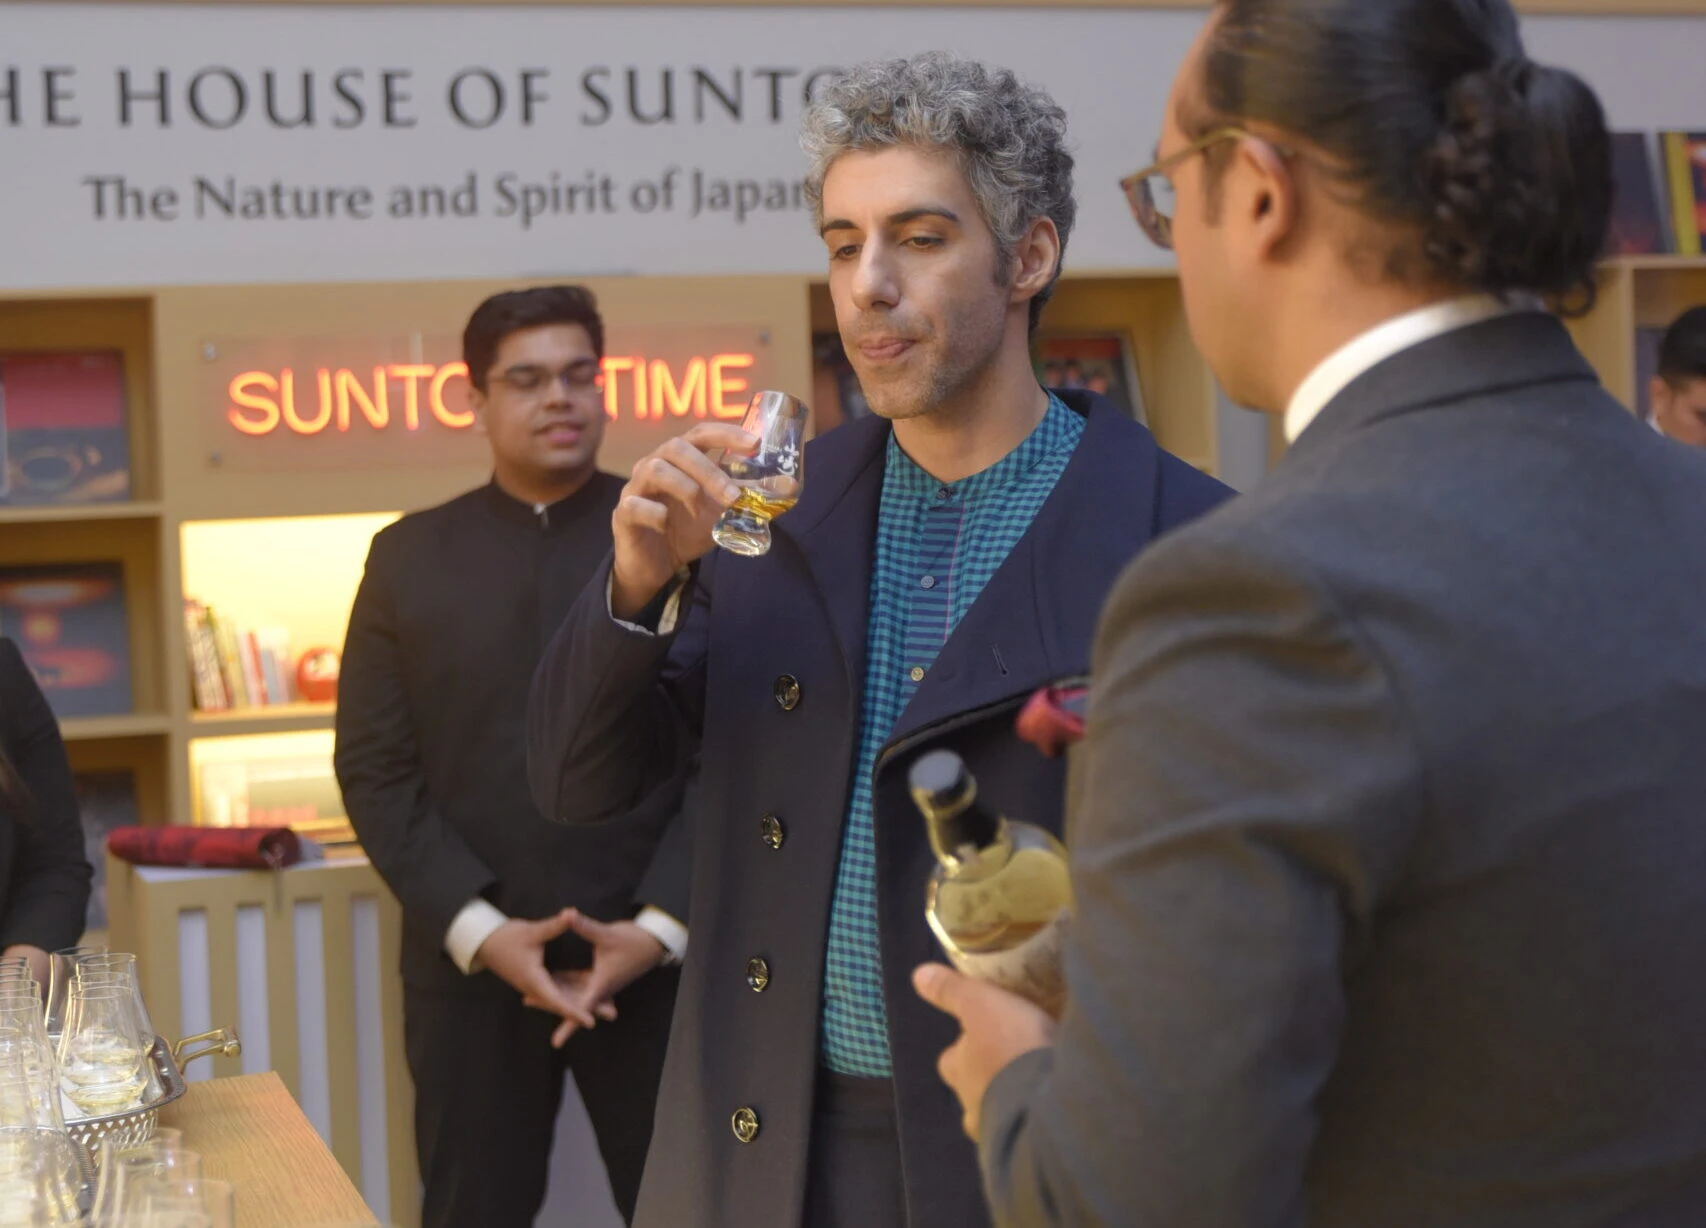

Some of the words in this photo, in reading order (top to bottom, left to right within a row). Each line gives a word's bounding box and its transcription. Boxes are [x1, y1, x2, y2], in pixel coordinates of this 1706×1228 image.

[116, 66, 416, 130] HOUSE
[446, 67, 549, 130] OF
[83, 175, 179, 220] The
[194, 176, 373, 219] Nature
[389, 172, 479, 217] and
[494, 174, 616, 229] Spirit
[630, 168, 678, 212] of
[598, 353, 754, 421] TIME
